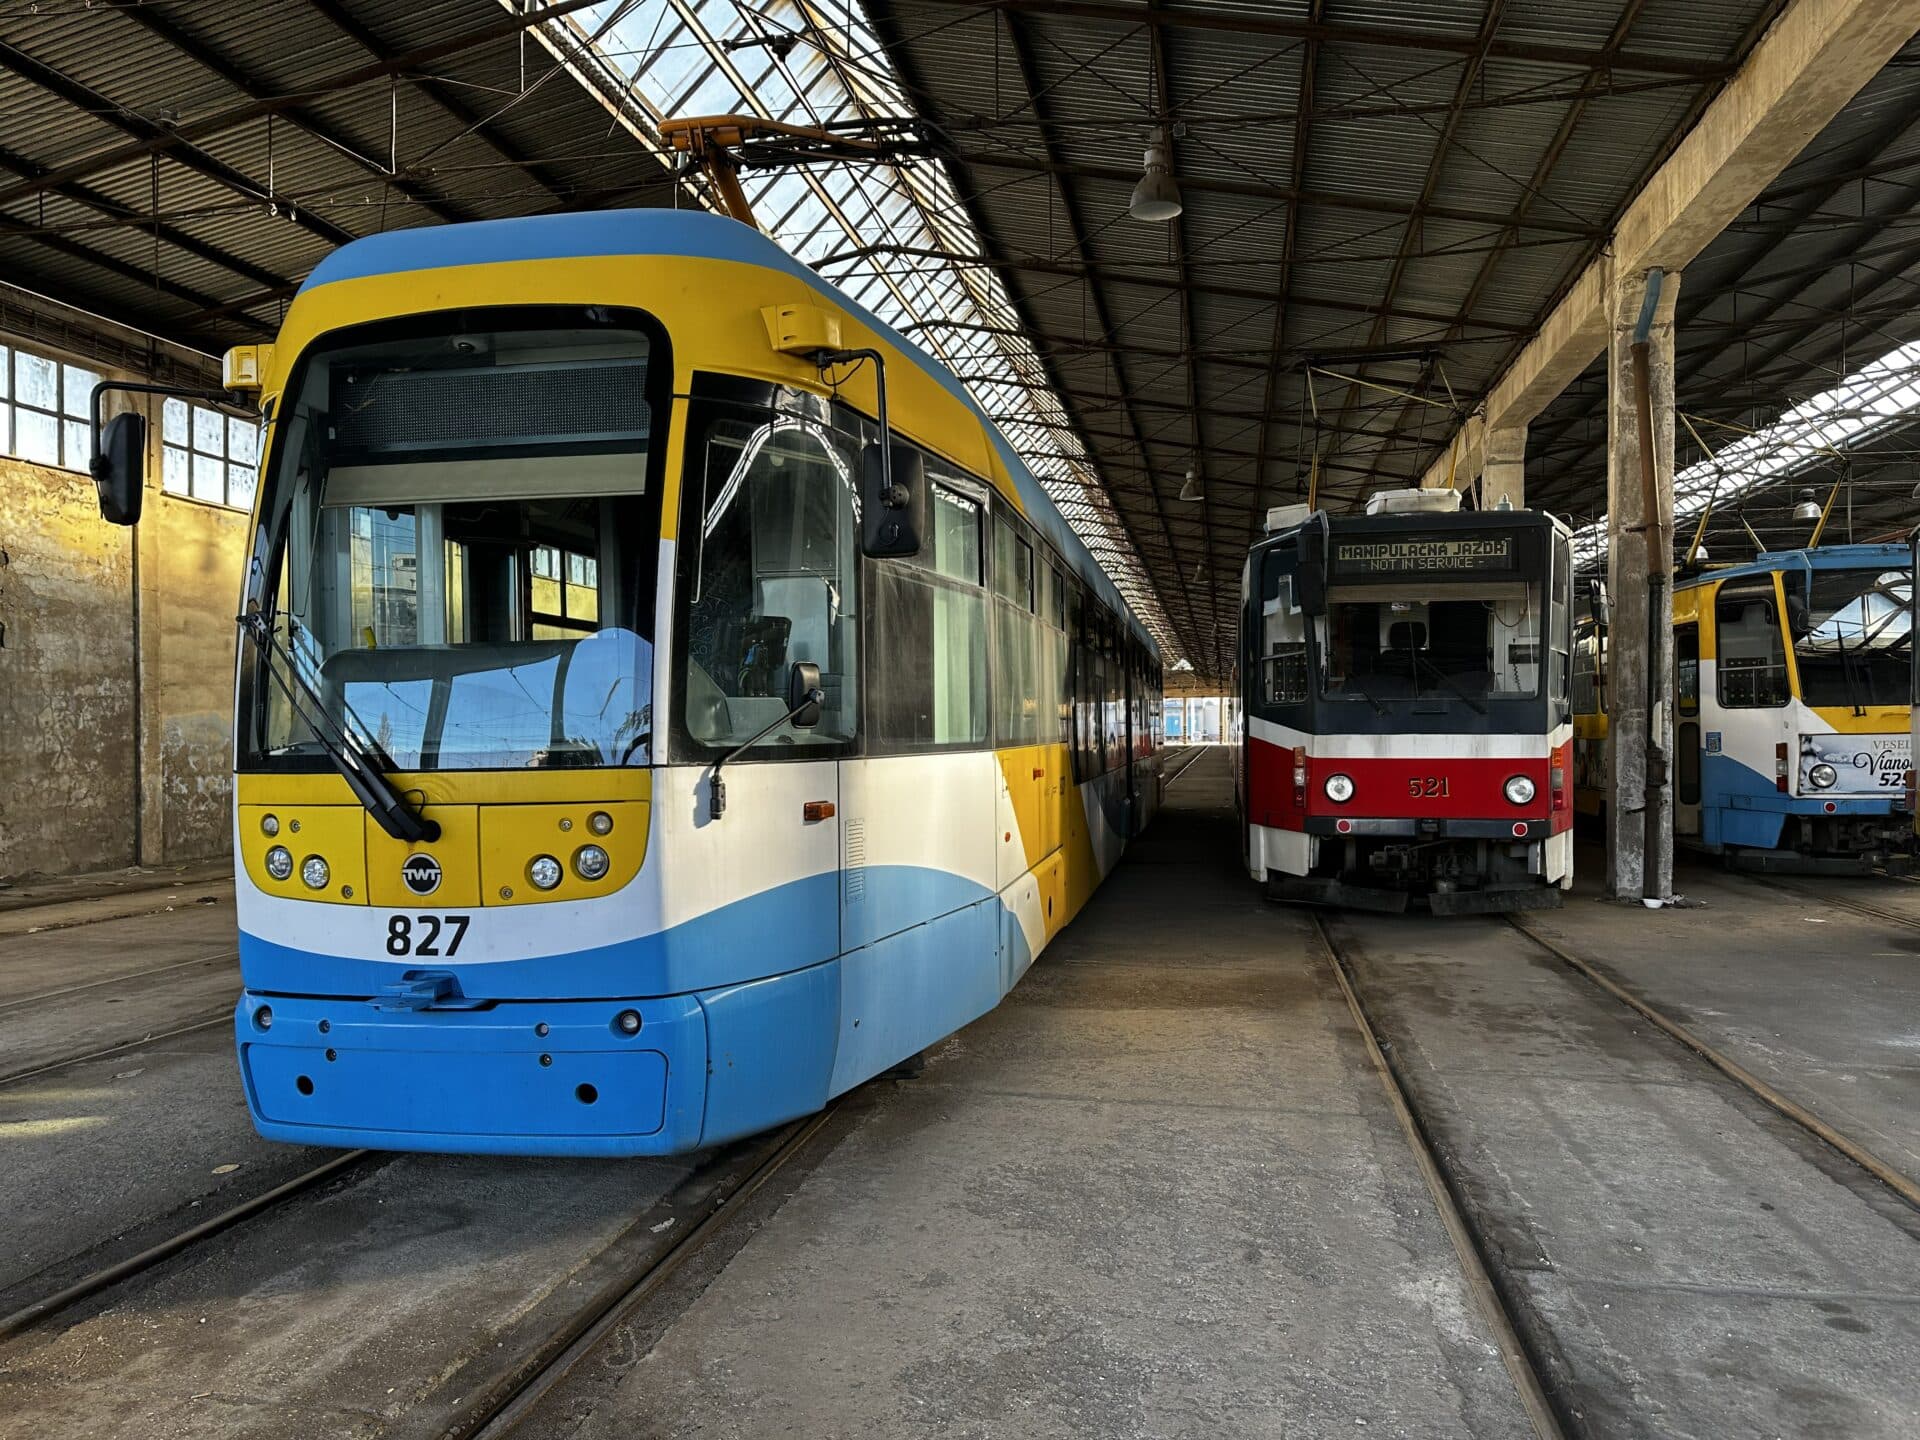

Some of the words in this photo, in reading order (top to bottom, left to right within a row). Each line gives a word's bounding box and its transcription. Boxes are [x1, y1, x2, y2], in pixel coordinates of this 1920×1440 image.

[1371, 559, 1397, 571] NOT
[1402, 558, 1413, 570] IN
[1418, 557, 1473, 569] SERVICE
[1853, 750, 1912, 775] Viano
[1408, 776, 1450, 798] 521
[386, 914, 471, 957] 827
